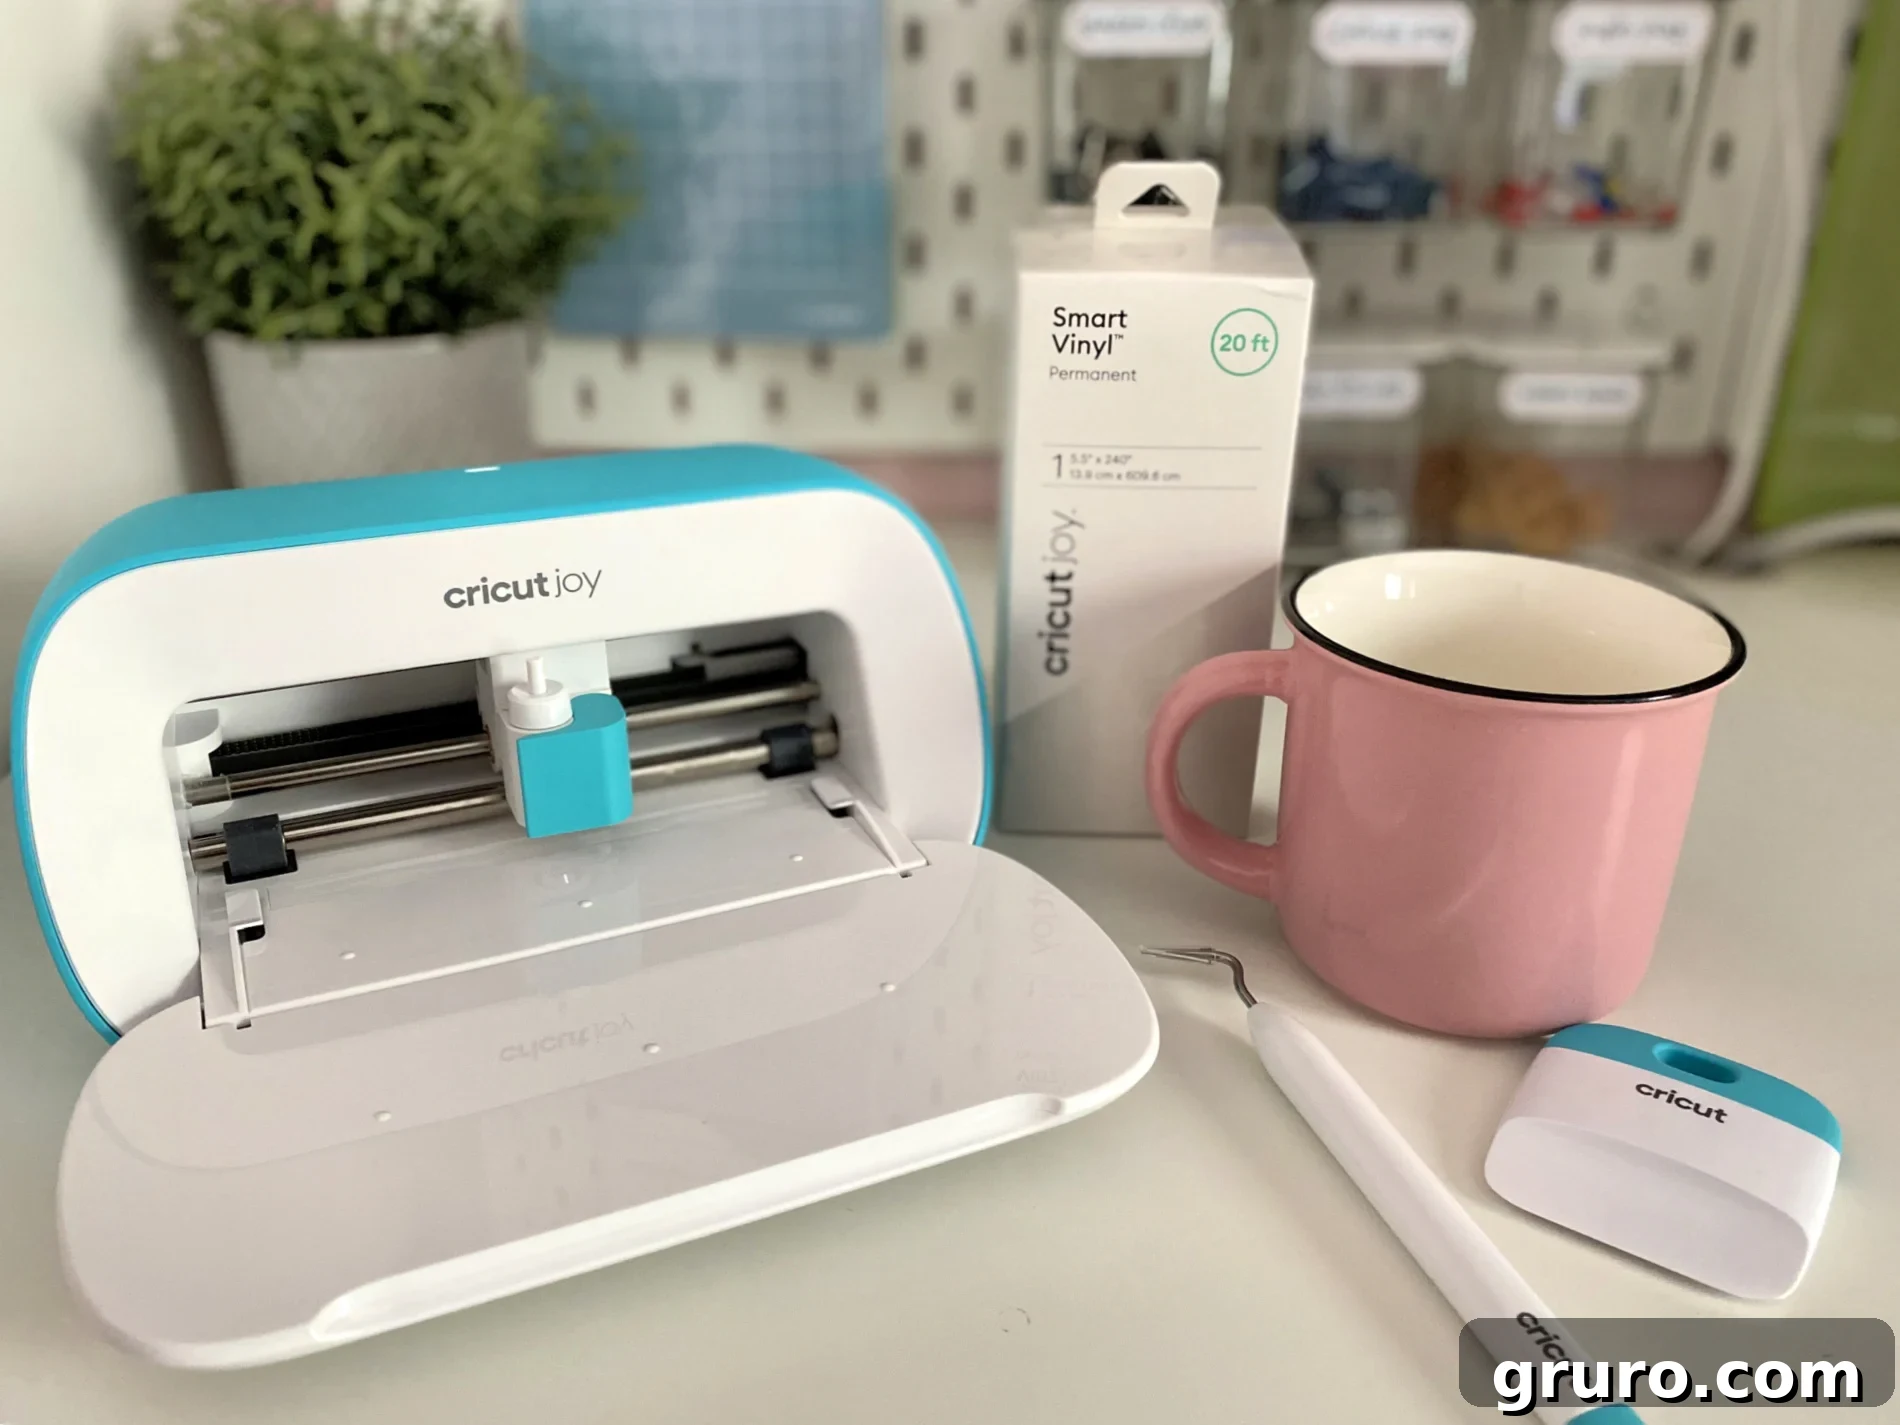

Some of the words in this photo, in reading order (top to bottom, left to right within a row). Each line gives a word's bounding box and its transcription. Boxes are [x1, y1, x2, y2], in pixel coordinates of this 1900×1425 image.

[1052, 306, 1128, 329] Smart
[1219, 334, 1247, 352] 20
[1250, 333, 1270, 352] ft
[1049, 365, 1137, 382] Permanent
[1052, 454, 1063, 479] 1
[1095, 471, 1114, 481] cm
[1162, 472, 1181, 482] cm
[443, 572, 550, 609] cricut
[555, 568, 602, 598] joy
[1036, 570, 1074, 677] cricut
[1635, 1083, 1728, 1124] cricut
